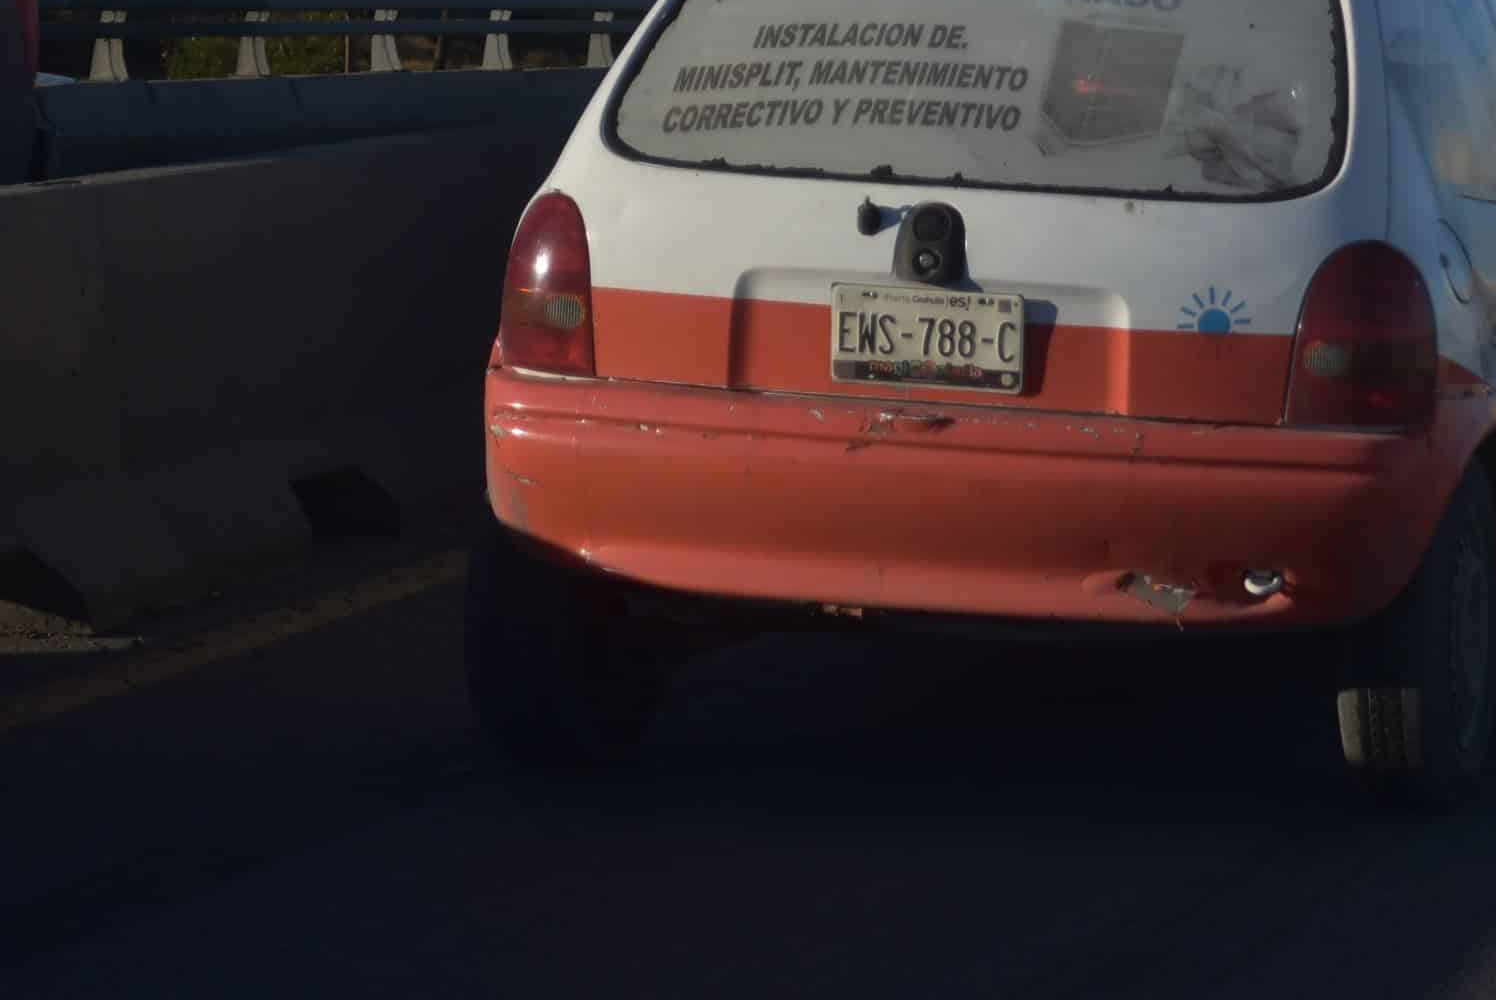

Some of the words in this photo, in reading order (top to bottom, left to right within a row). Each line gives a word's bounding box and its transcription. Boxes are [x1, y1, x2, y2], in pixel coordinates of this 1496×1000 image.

[752, 22, 925, 49] INSTALACION
[927, 23, 969, 50] DE.
[672, 60, 803, 93] MINISPLIT,
[808, 59, 1029, 92] MANTENIMIENTO
[662, 99, 824, 133] CORRECTIVO
[830, 98, 850, 127] Y
[852, 98, 1022, 132] PREVENTIVO
[838, 310, 1017, 363] EWS-788-C
